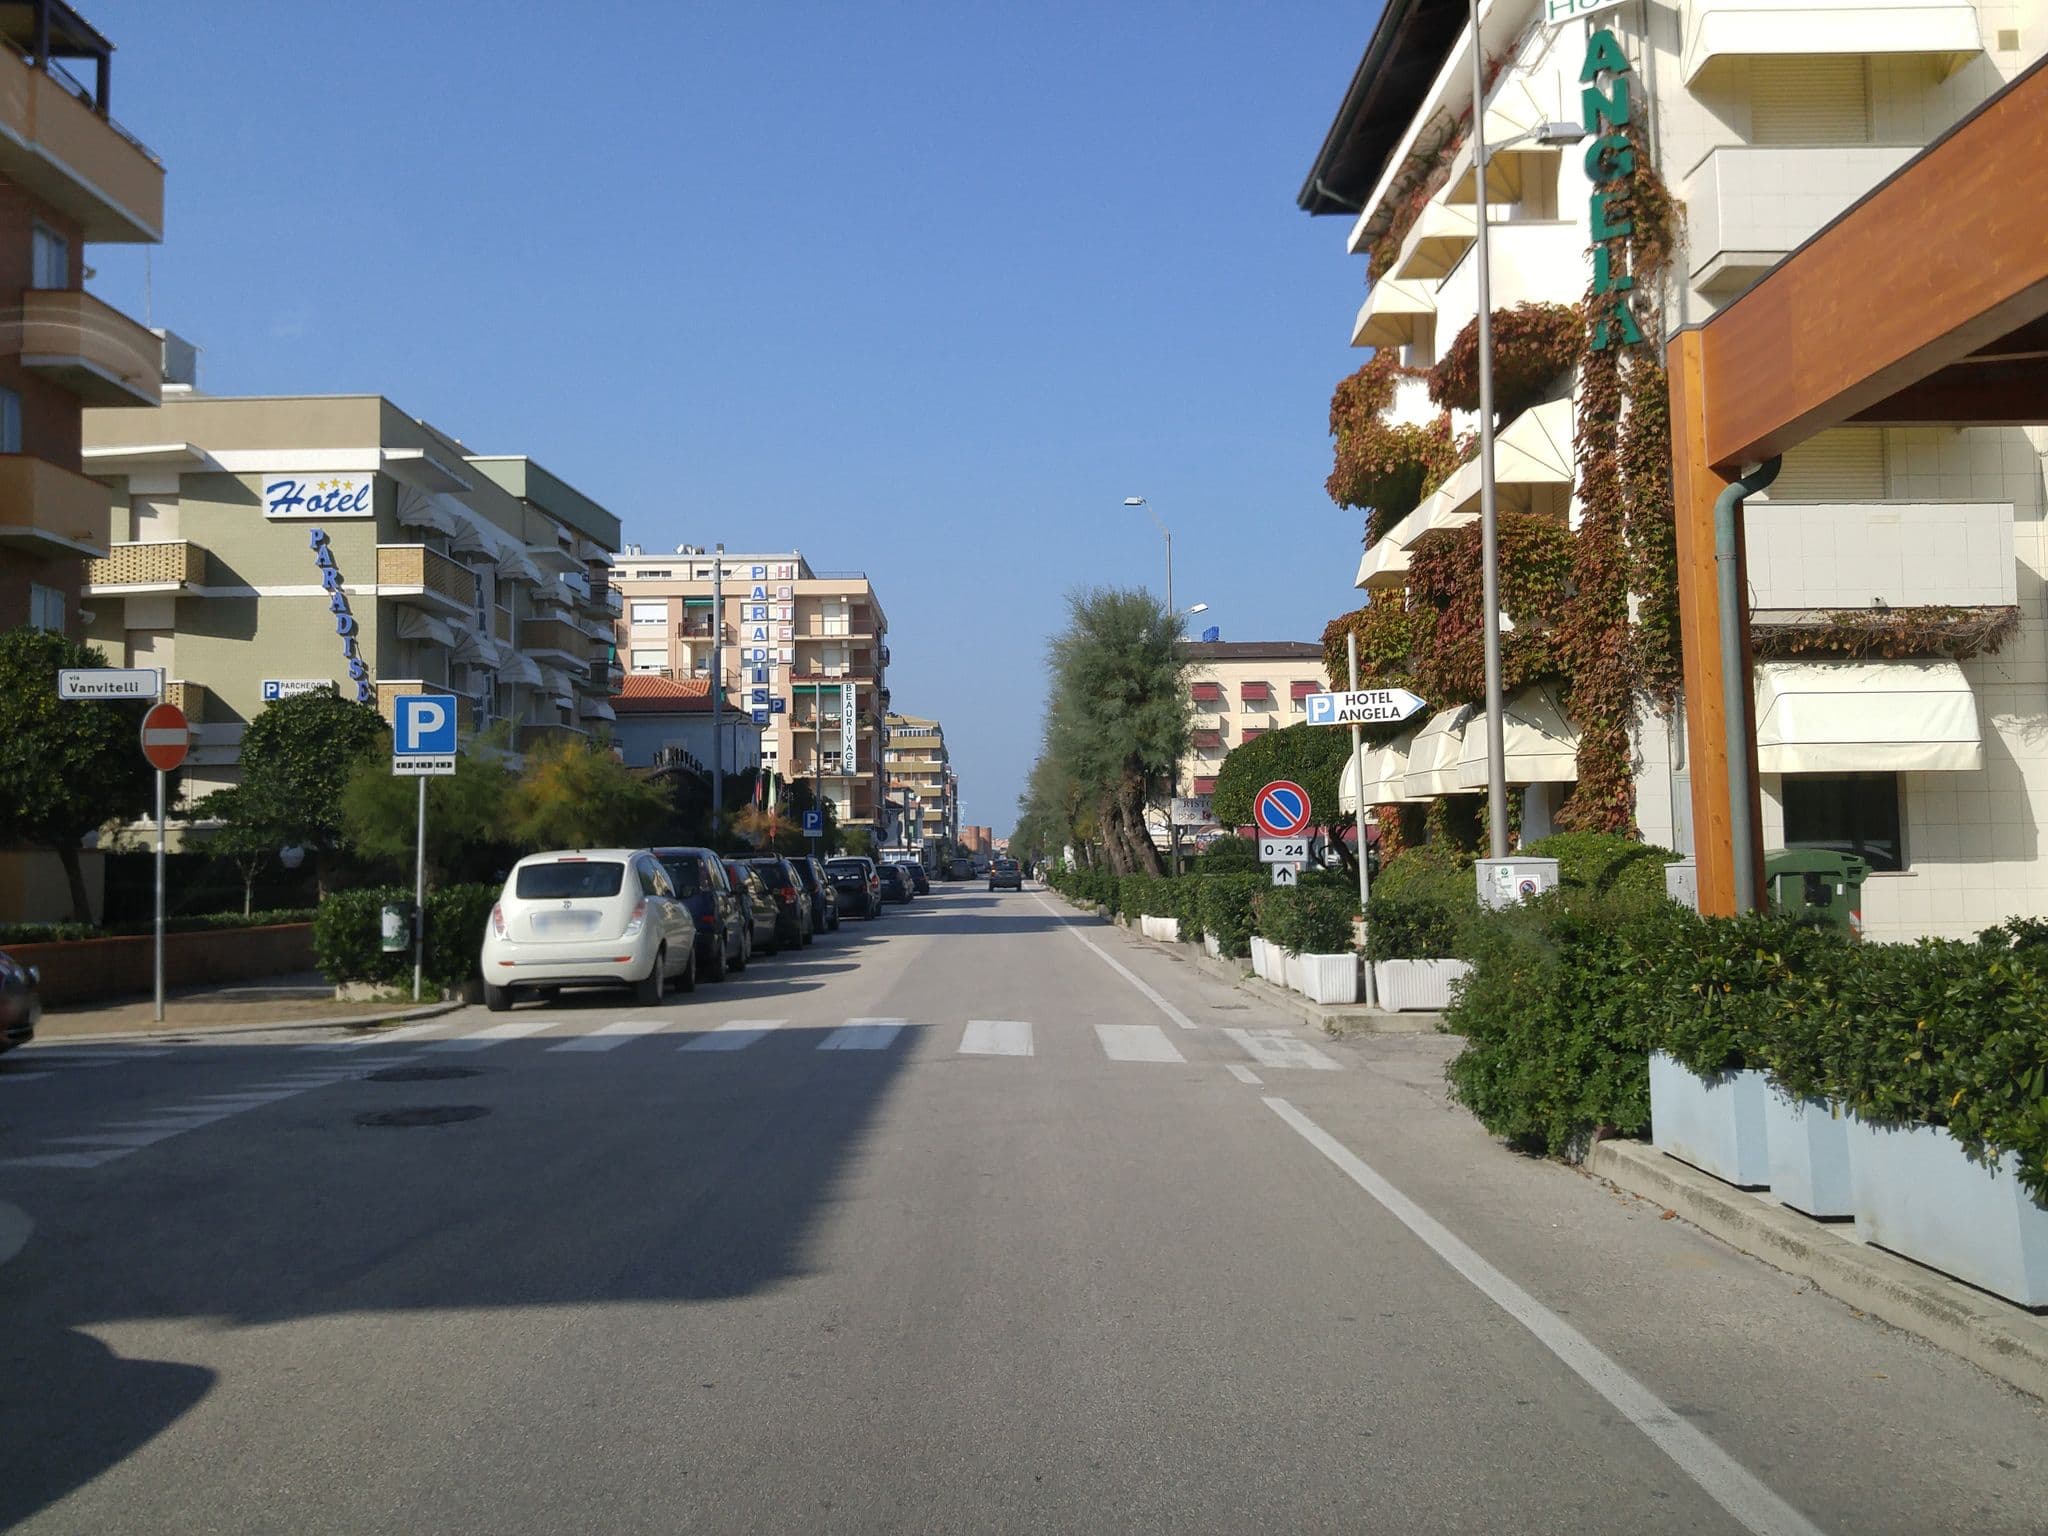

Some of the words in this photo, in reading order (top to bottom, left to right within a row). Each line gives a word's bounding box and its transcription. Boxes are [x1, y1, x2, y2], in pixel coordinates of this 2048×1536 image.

[1579, 29, 1642, 350] ANGELA
[266, 480, 370, 513] Hotel
[310, 528, 369, 701] PARADISE
[777, 565, 791, 662] HOTEL
[751, 566, 766, 723] PARADISE
[70, 682, 139, 693] Vanvitelli
[1312, 698, 1331, 721] P
[1345, 692, 1393, 706] HOTEL
[408, 702, 445, 749] P
[845, 684, 854, 769] BEAURIVAGE
[1338, 707, 1401, 721] ANGELA
